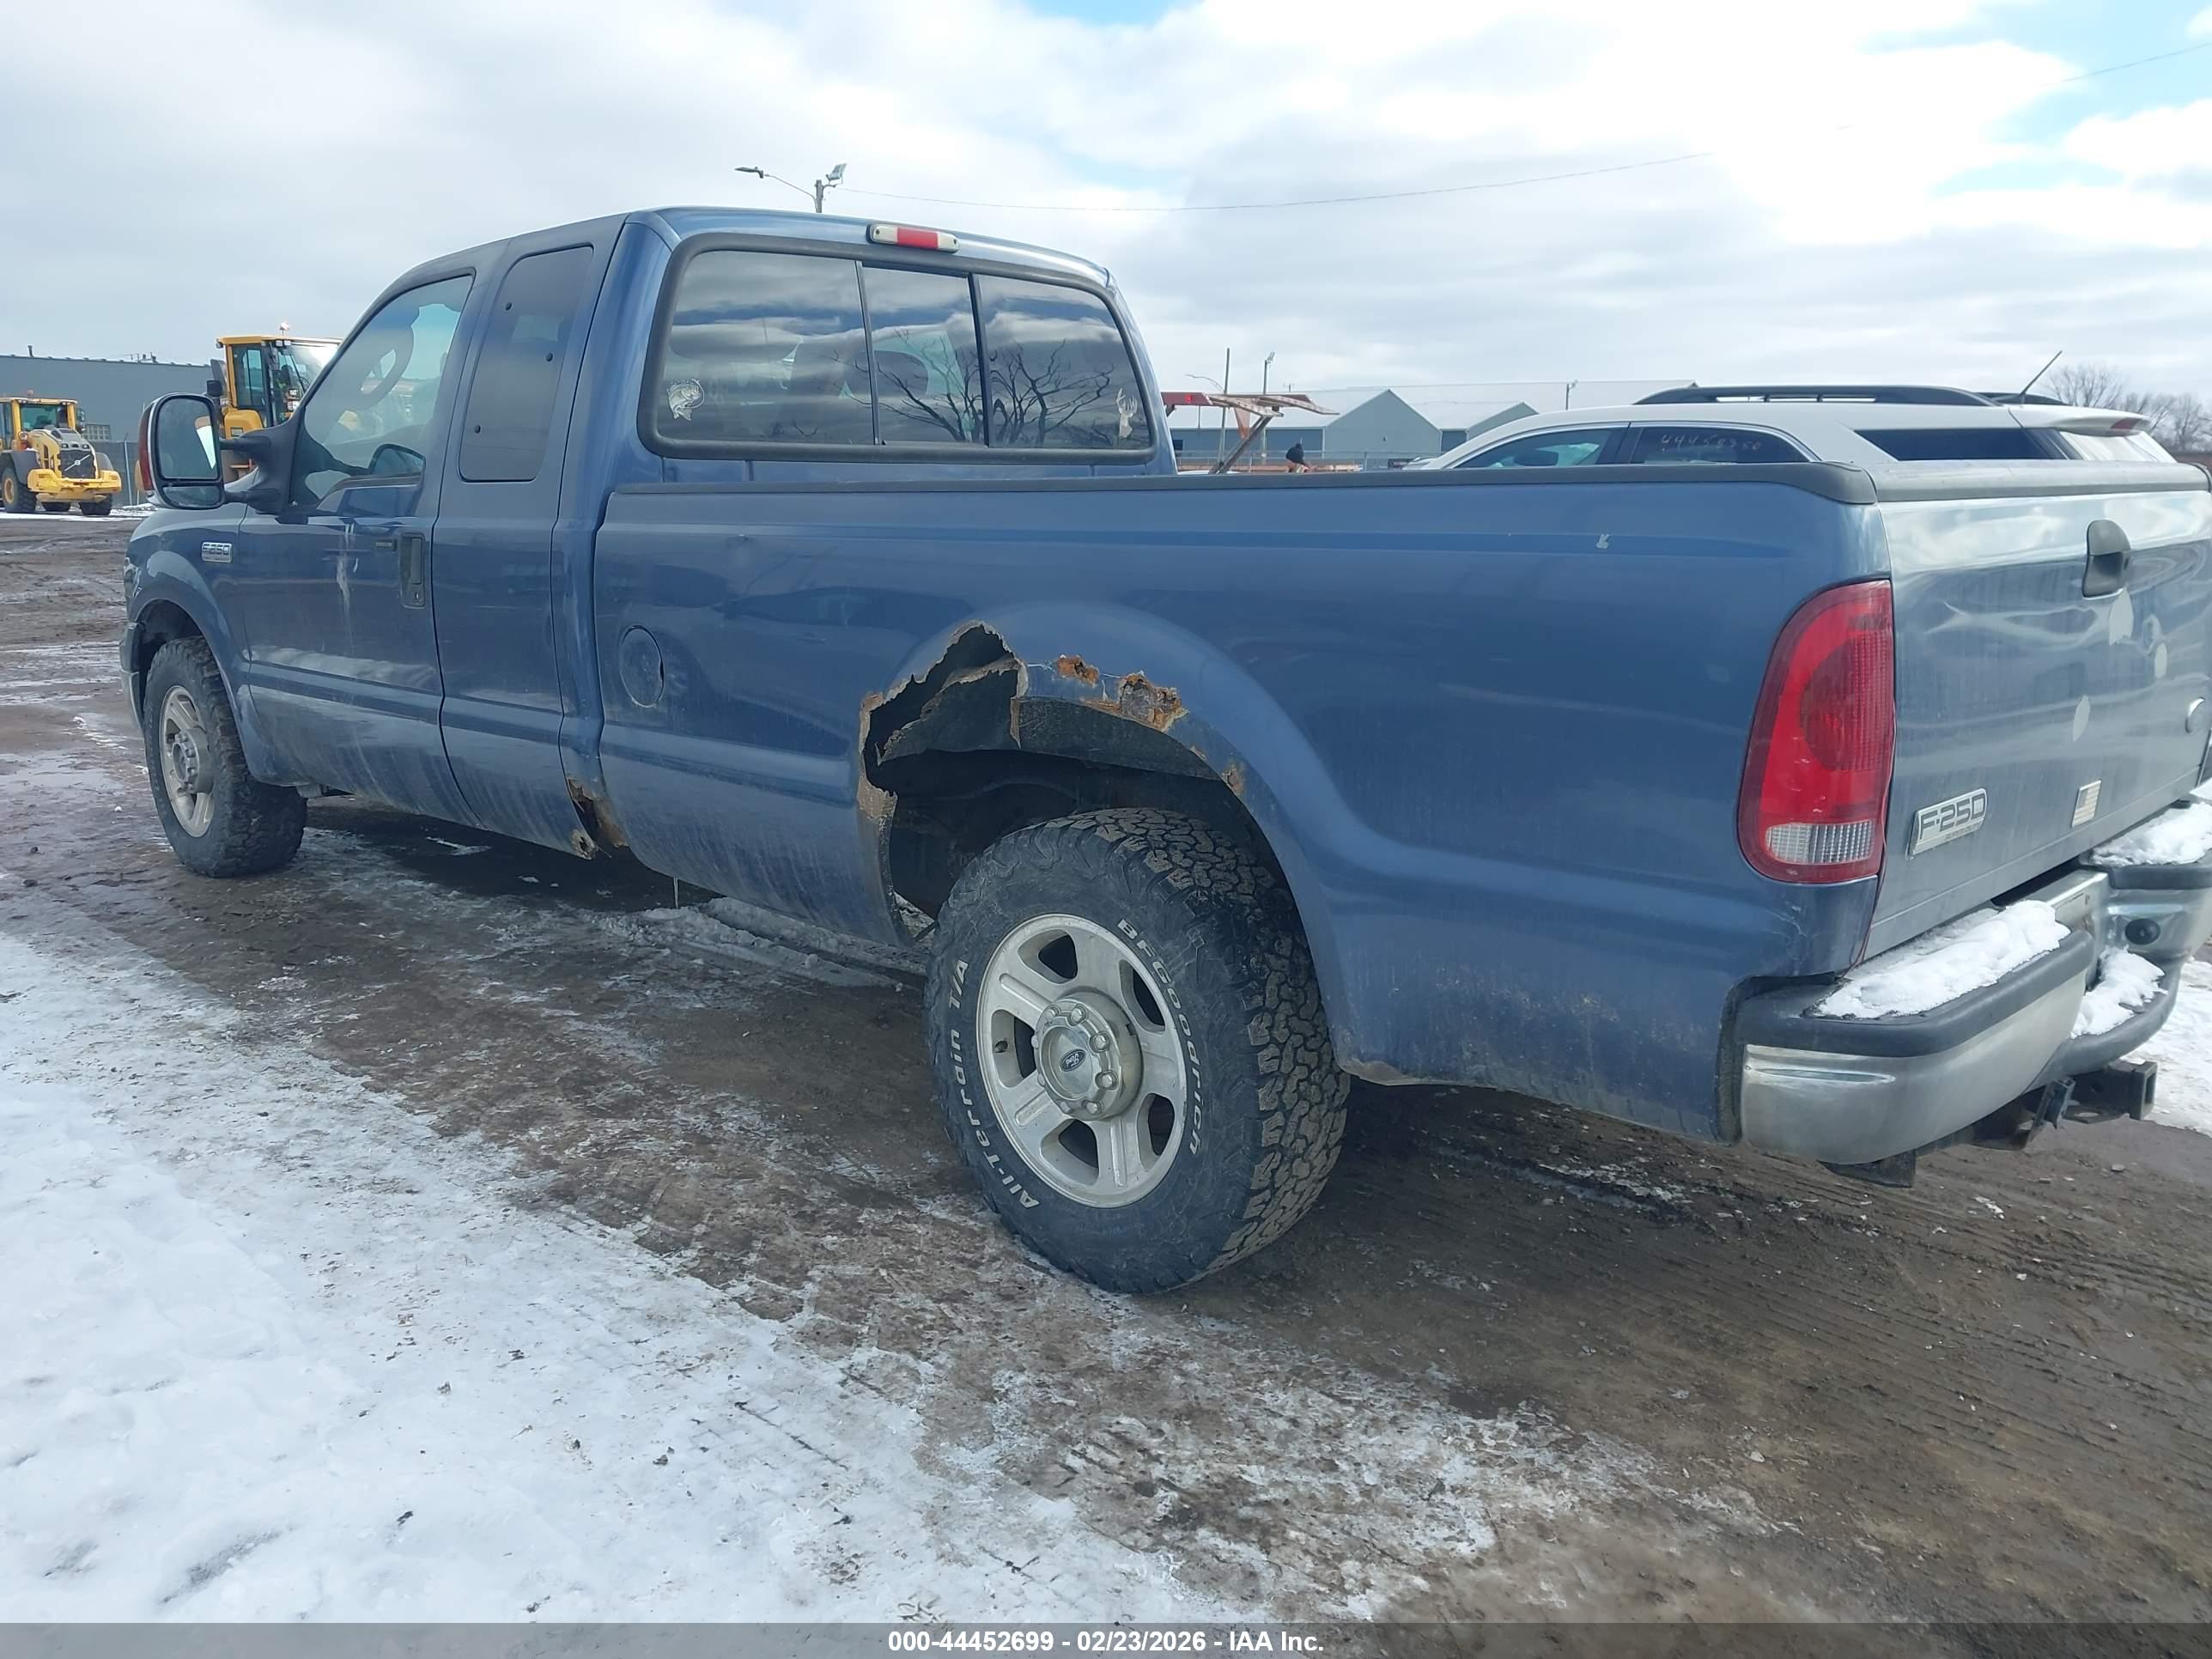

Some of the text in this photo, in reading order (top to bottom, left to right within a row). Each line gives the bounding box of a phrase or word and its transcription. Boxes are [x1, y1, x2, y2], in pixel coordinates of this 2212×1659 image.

[1918, 793, 1985, 841] F-250
[949, 959, 1040, 1208] All-Terrain T/A
[1117, 919, 1202, 1155] BFGoodrich
